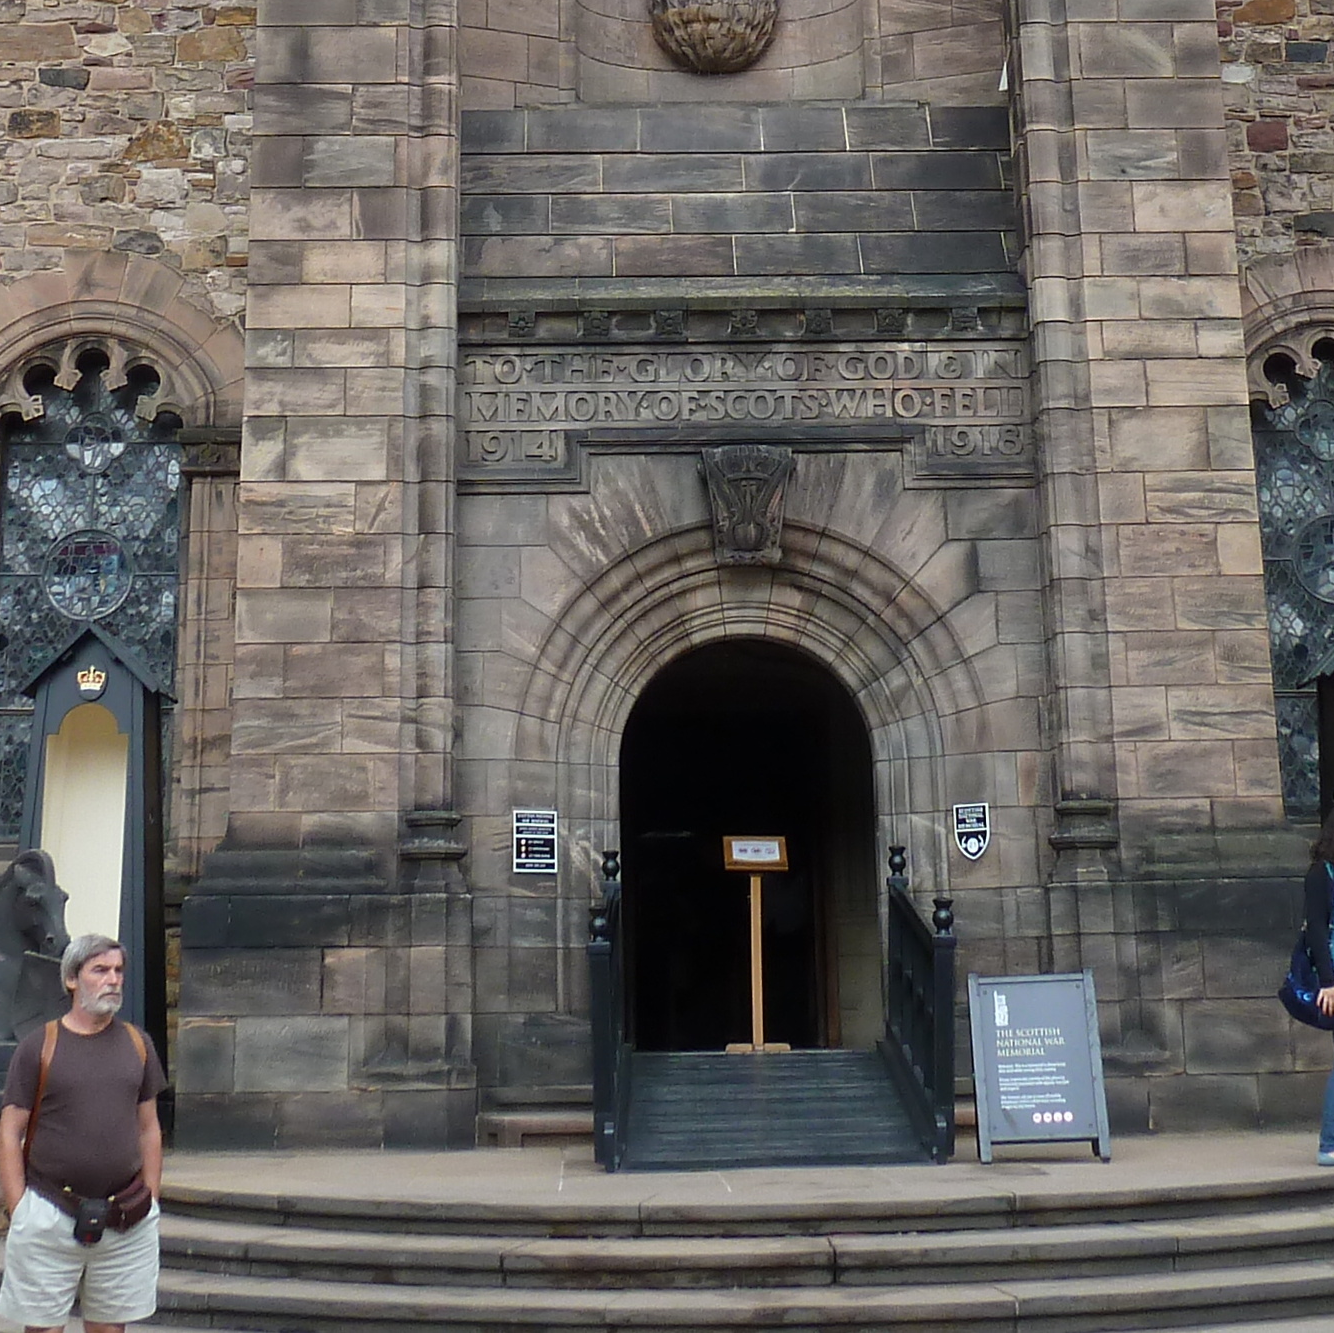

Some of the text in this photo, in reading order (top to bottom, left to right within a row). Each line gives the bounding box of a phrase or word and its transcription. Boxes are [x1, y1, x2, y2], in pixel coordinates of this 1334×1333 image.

[464, 350, 1021, 384] TO THE GLORY OF GOD & IN
[466, 387, 1023, 422] MEMORY OF SCOTS WHO FELL
[467, 424, 1024, 462] 1914 1918
[996, 1036, 1065, 1048] NATIONAL WAR
